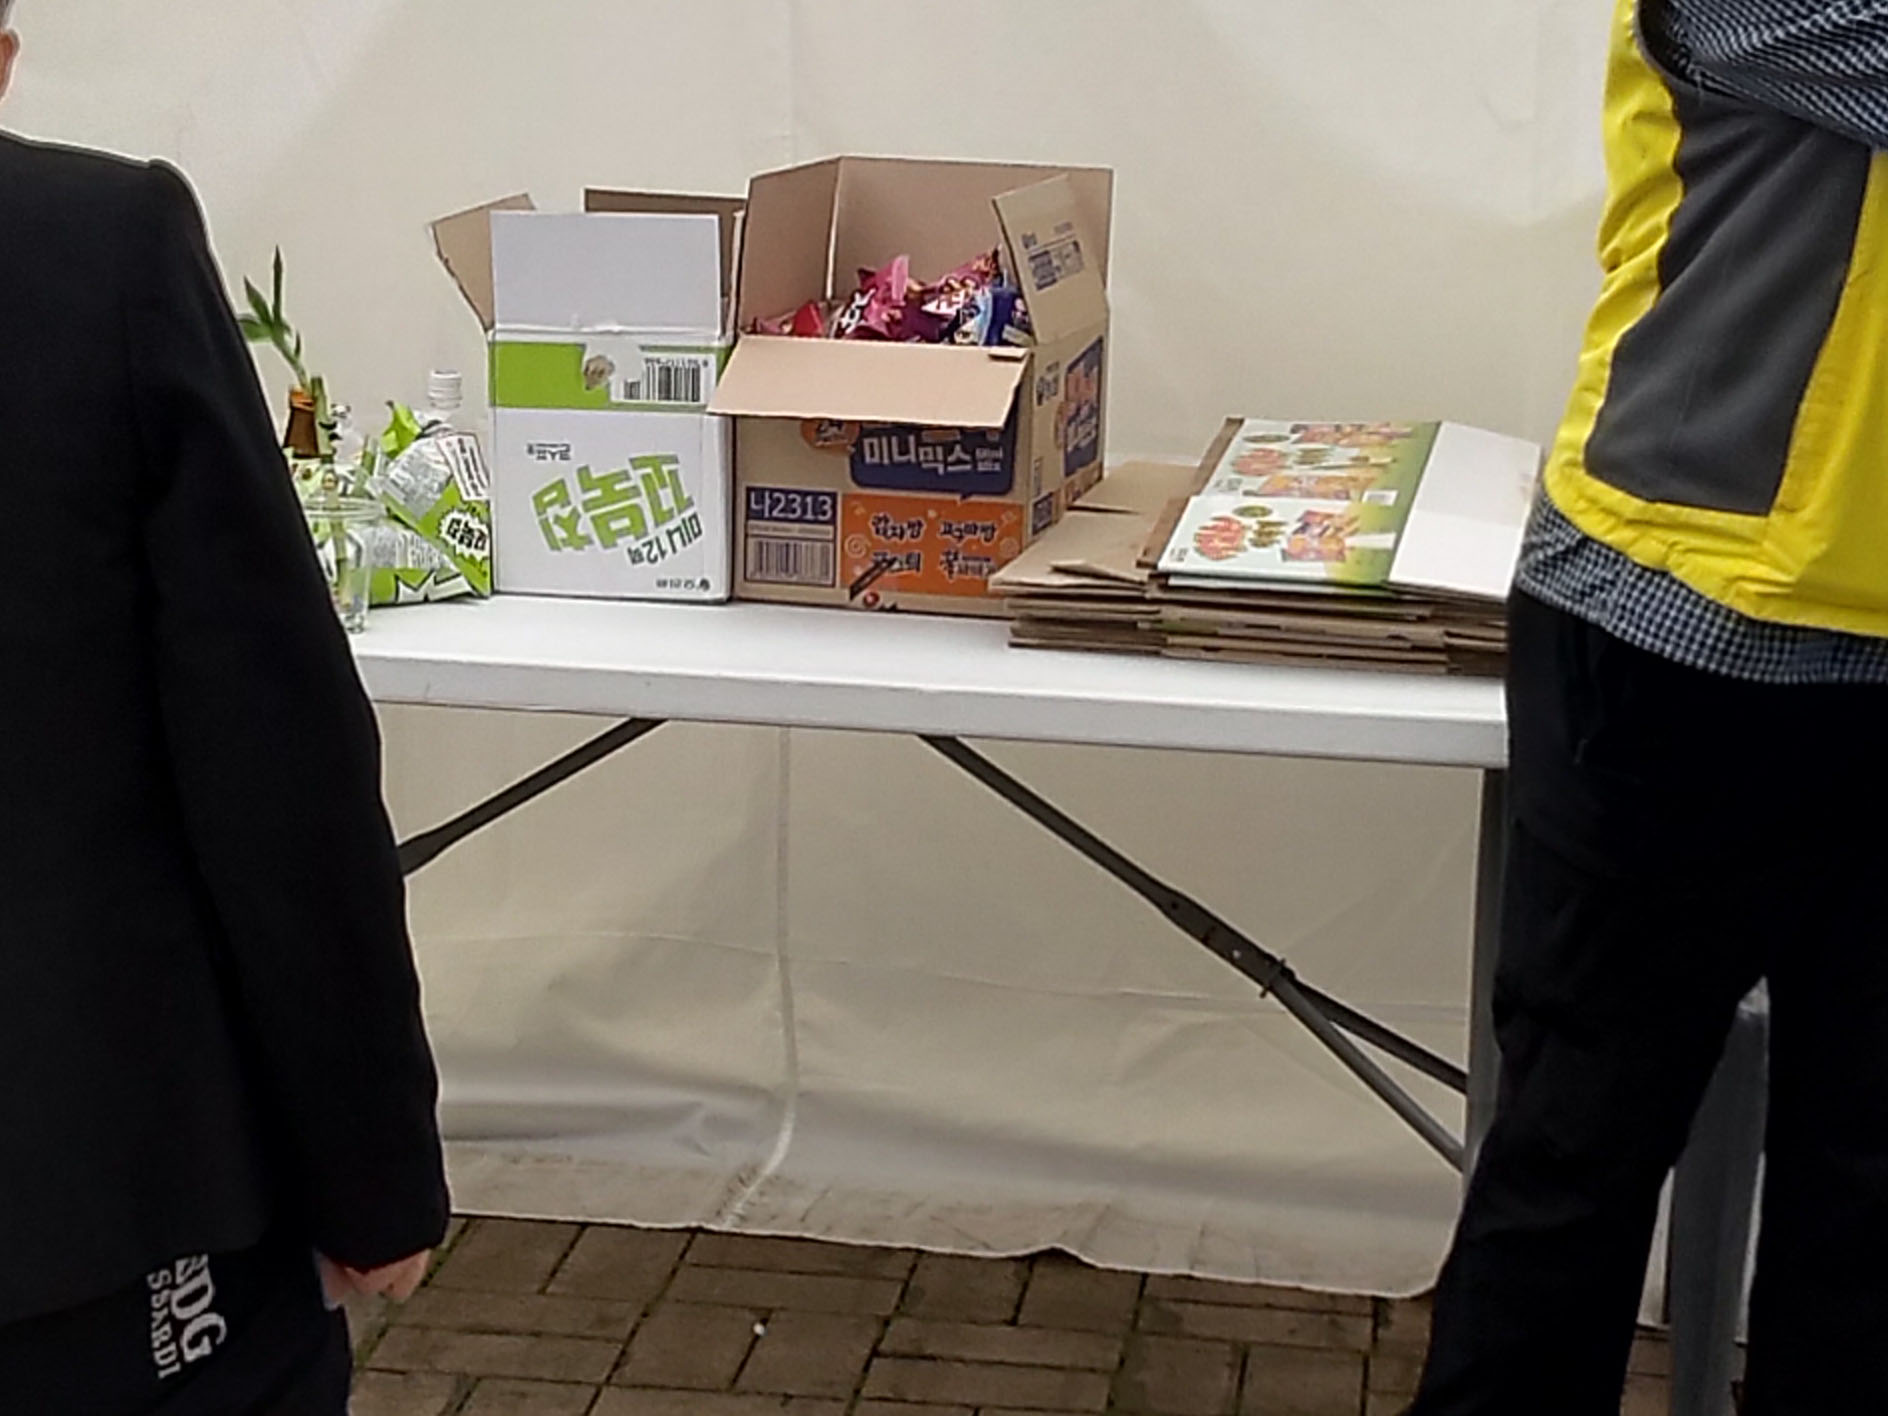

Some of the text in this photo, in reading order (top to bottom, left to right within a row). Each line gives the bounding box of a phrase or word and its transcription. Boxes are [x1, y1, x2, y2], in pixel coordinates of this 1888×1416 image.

[863, 434, 973, 475] 미니믹스
[531, 452, 695, 552] 꼬북칩
[750, 491, 832, 521] 나2313
